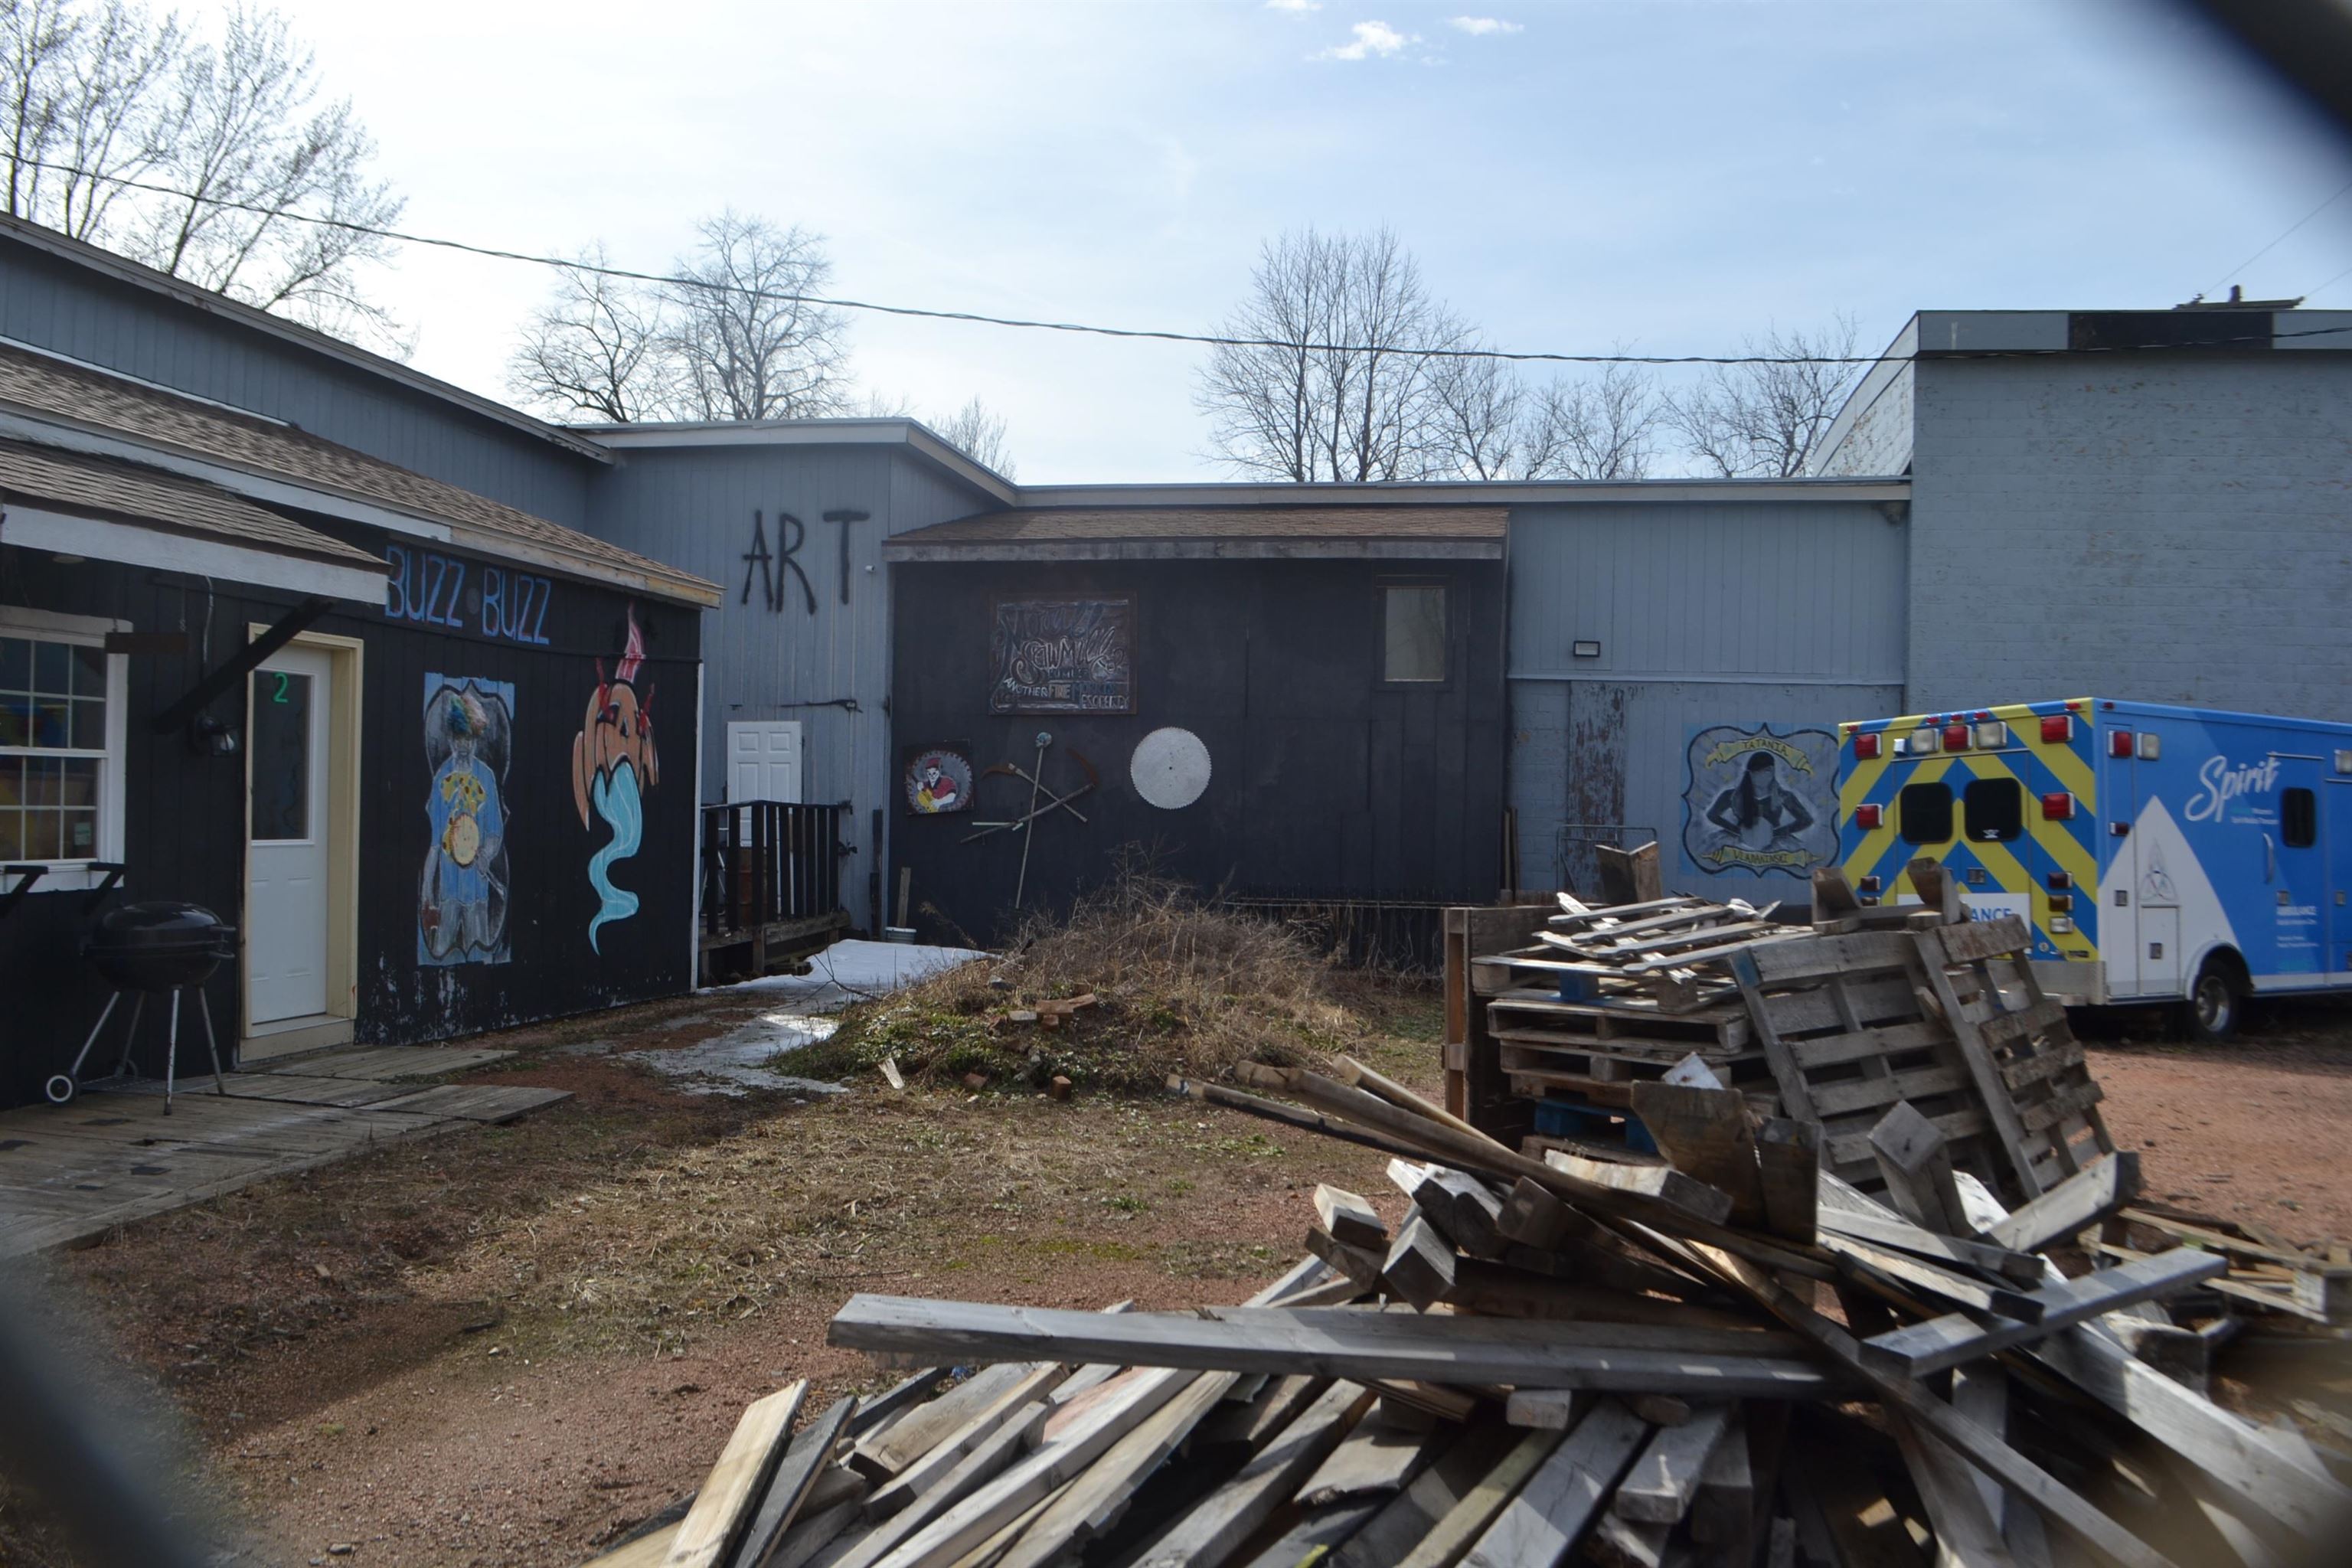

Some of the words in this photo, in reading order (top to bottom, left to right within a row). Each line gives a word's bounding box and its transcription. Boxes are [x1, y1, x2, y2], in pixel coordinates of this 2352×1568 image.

[385, 544, 465, 627] BUZZ
[482, 567, 551, 645] BUZZ
[740, 510, 871, 616] ART
[273, 671, 289, 703] 2
[1003, 677, 1048, 697] ANOTHER
[2184, 751, 2282, 824] Spirit
